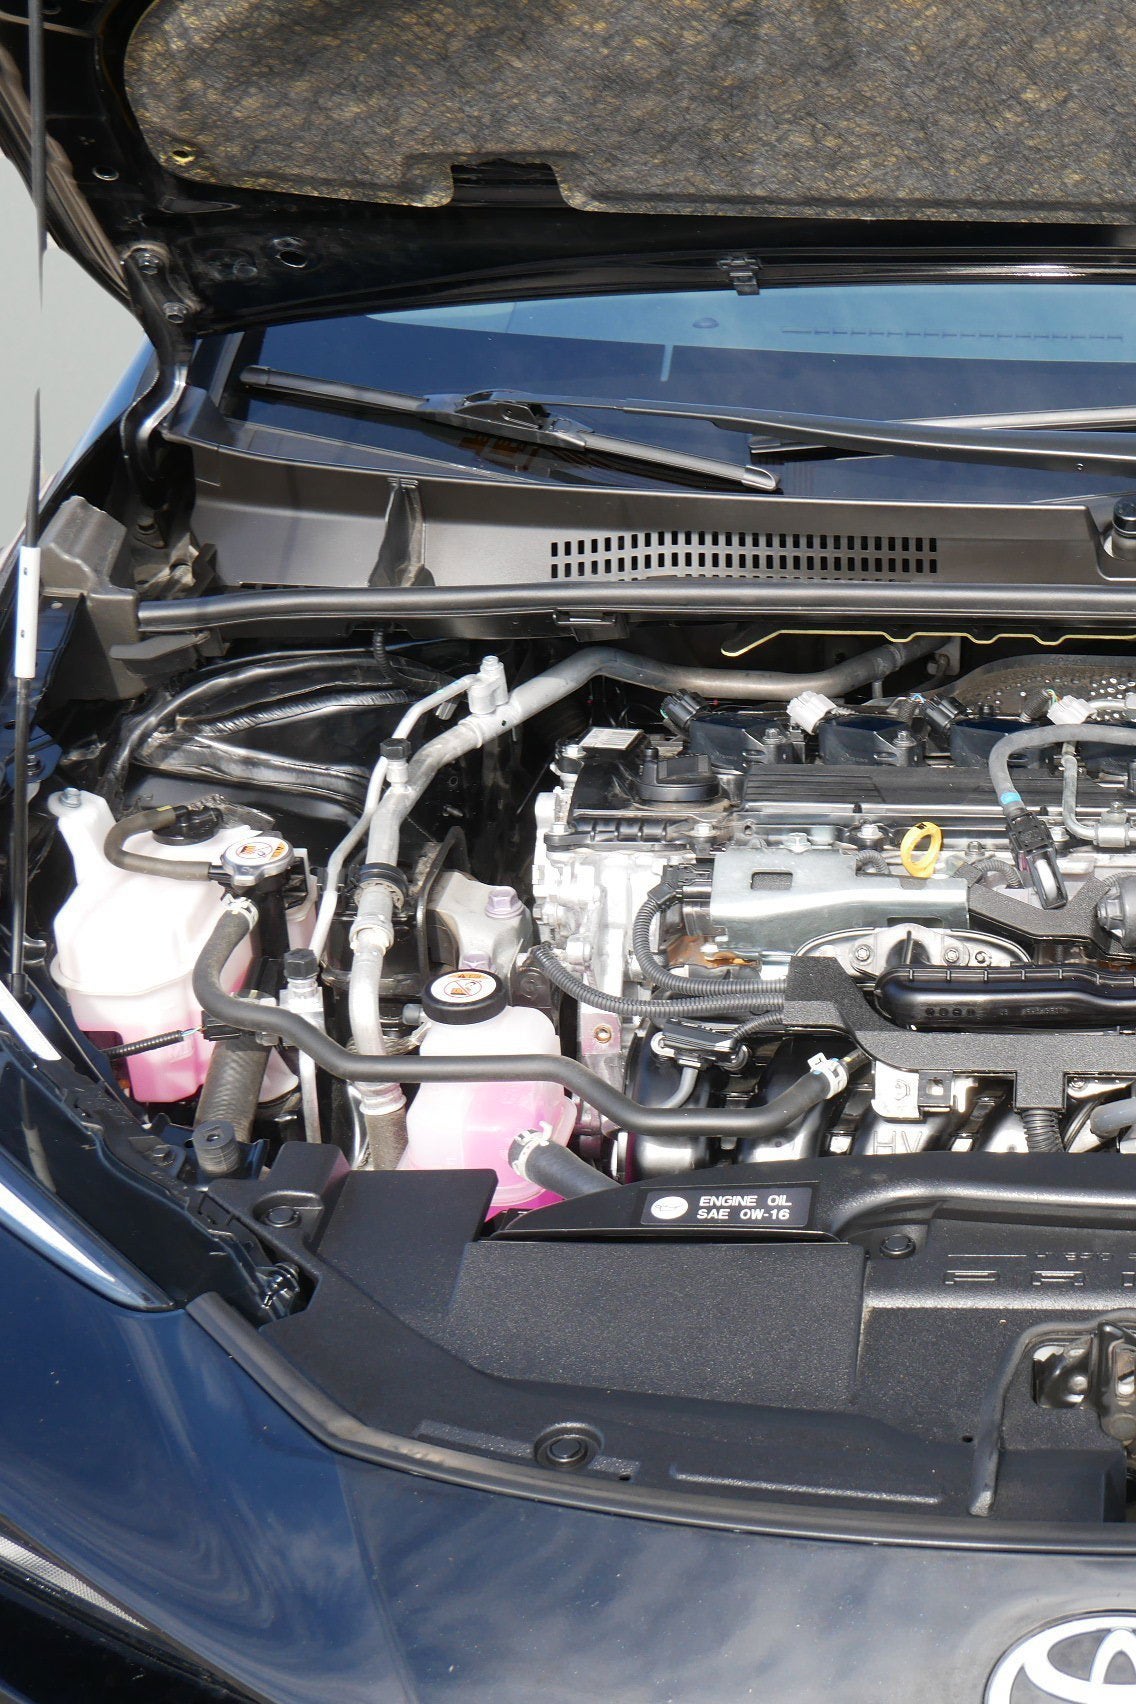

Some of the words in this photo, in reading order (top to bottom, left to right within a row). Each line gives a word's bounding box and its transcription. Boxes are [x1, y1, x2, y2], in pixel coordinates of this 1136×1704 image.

[699, 1195, 758, 1207] ENGINE
[767, 1194, 792, 1206] OIL
[697, 1208, 730, 1219] SAE
